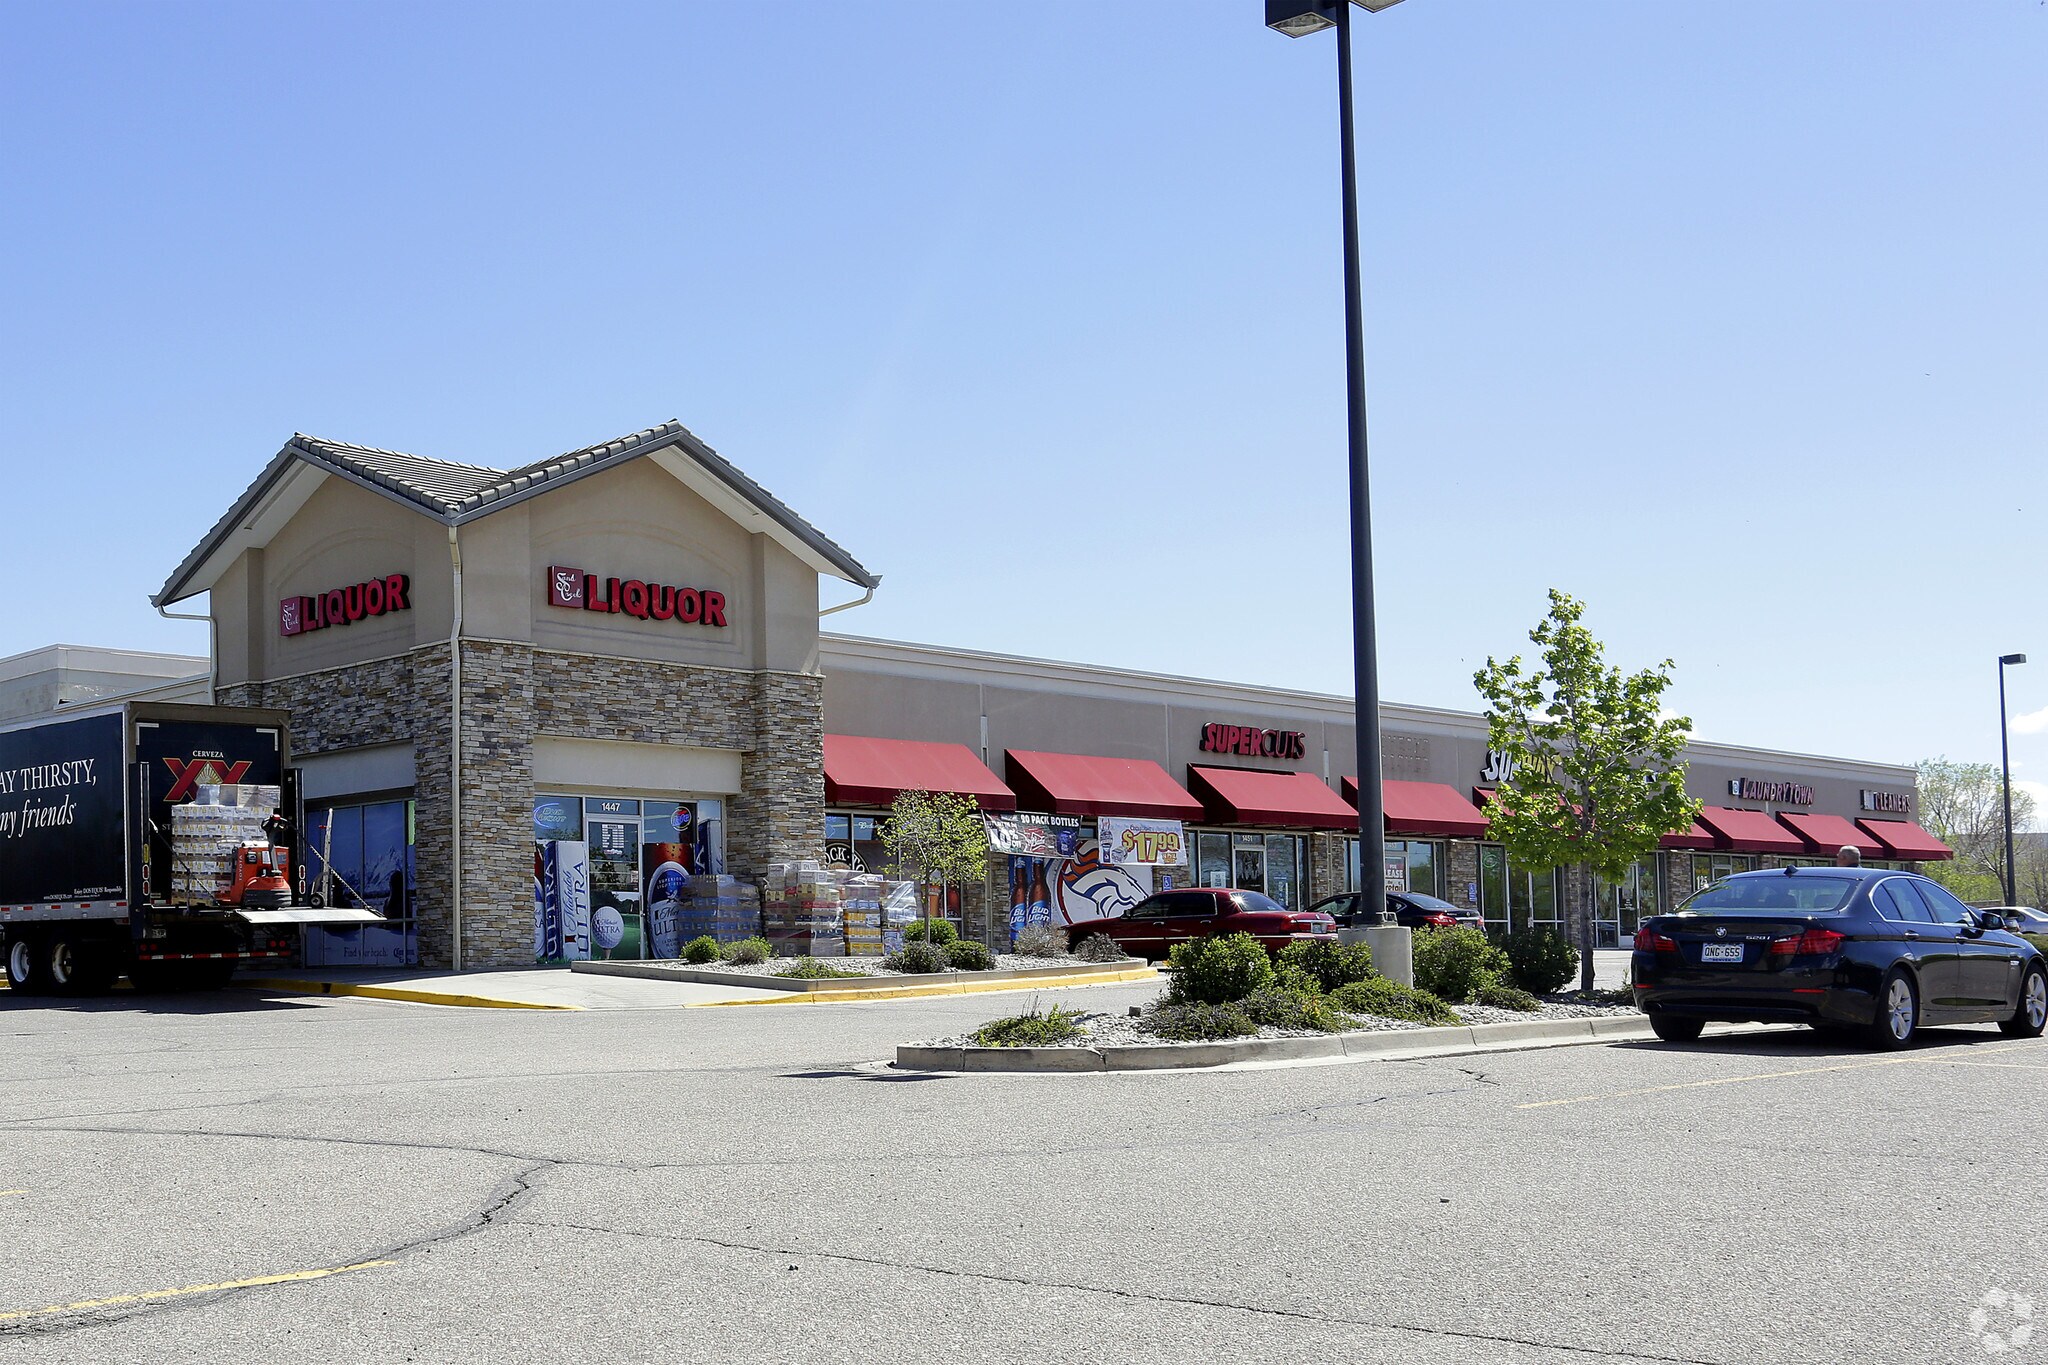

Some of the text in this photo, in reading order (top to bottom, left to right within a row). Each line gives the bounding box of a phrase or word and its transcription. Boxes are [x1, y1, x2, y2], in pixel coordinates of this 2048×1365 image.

[303, 574, 410, 631] LIQUOR
[584, 574, 727, 626] LIQUOR
[192, 750, 224, 758] CERVEZA
[1200, 722, 1306, 759] SUPERCUTS
[20, 758, 97, 791] THIRSTY,
[601, 802, 621, 812] 1447
[1874, 791, 1911, 813] CLEANERS
[1031, 815, 1050, 825] PACK
[1050, 816, 1080, 828] BOTTLES
[545, 860, 557, 956] ULTRA
[573, 862, 589, 953] ULTRA
[1031, 906, 1049, 915] BUD
